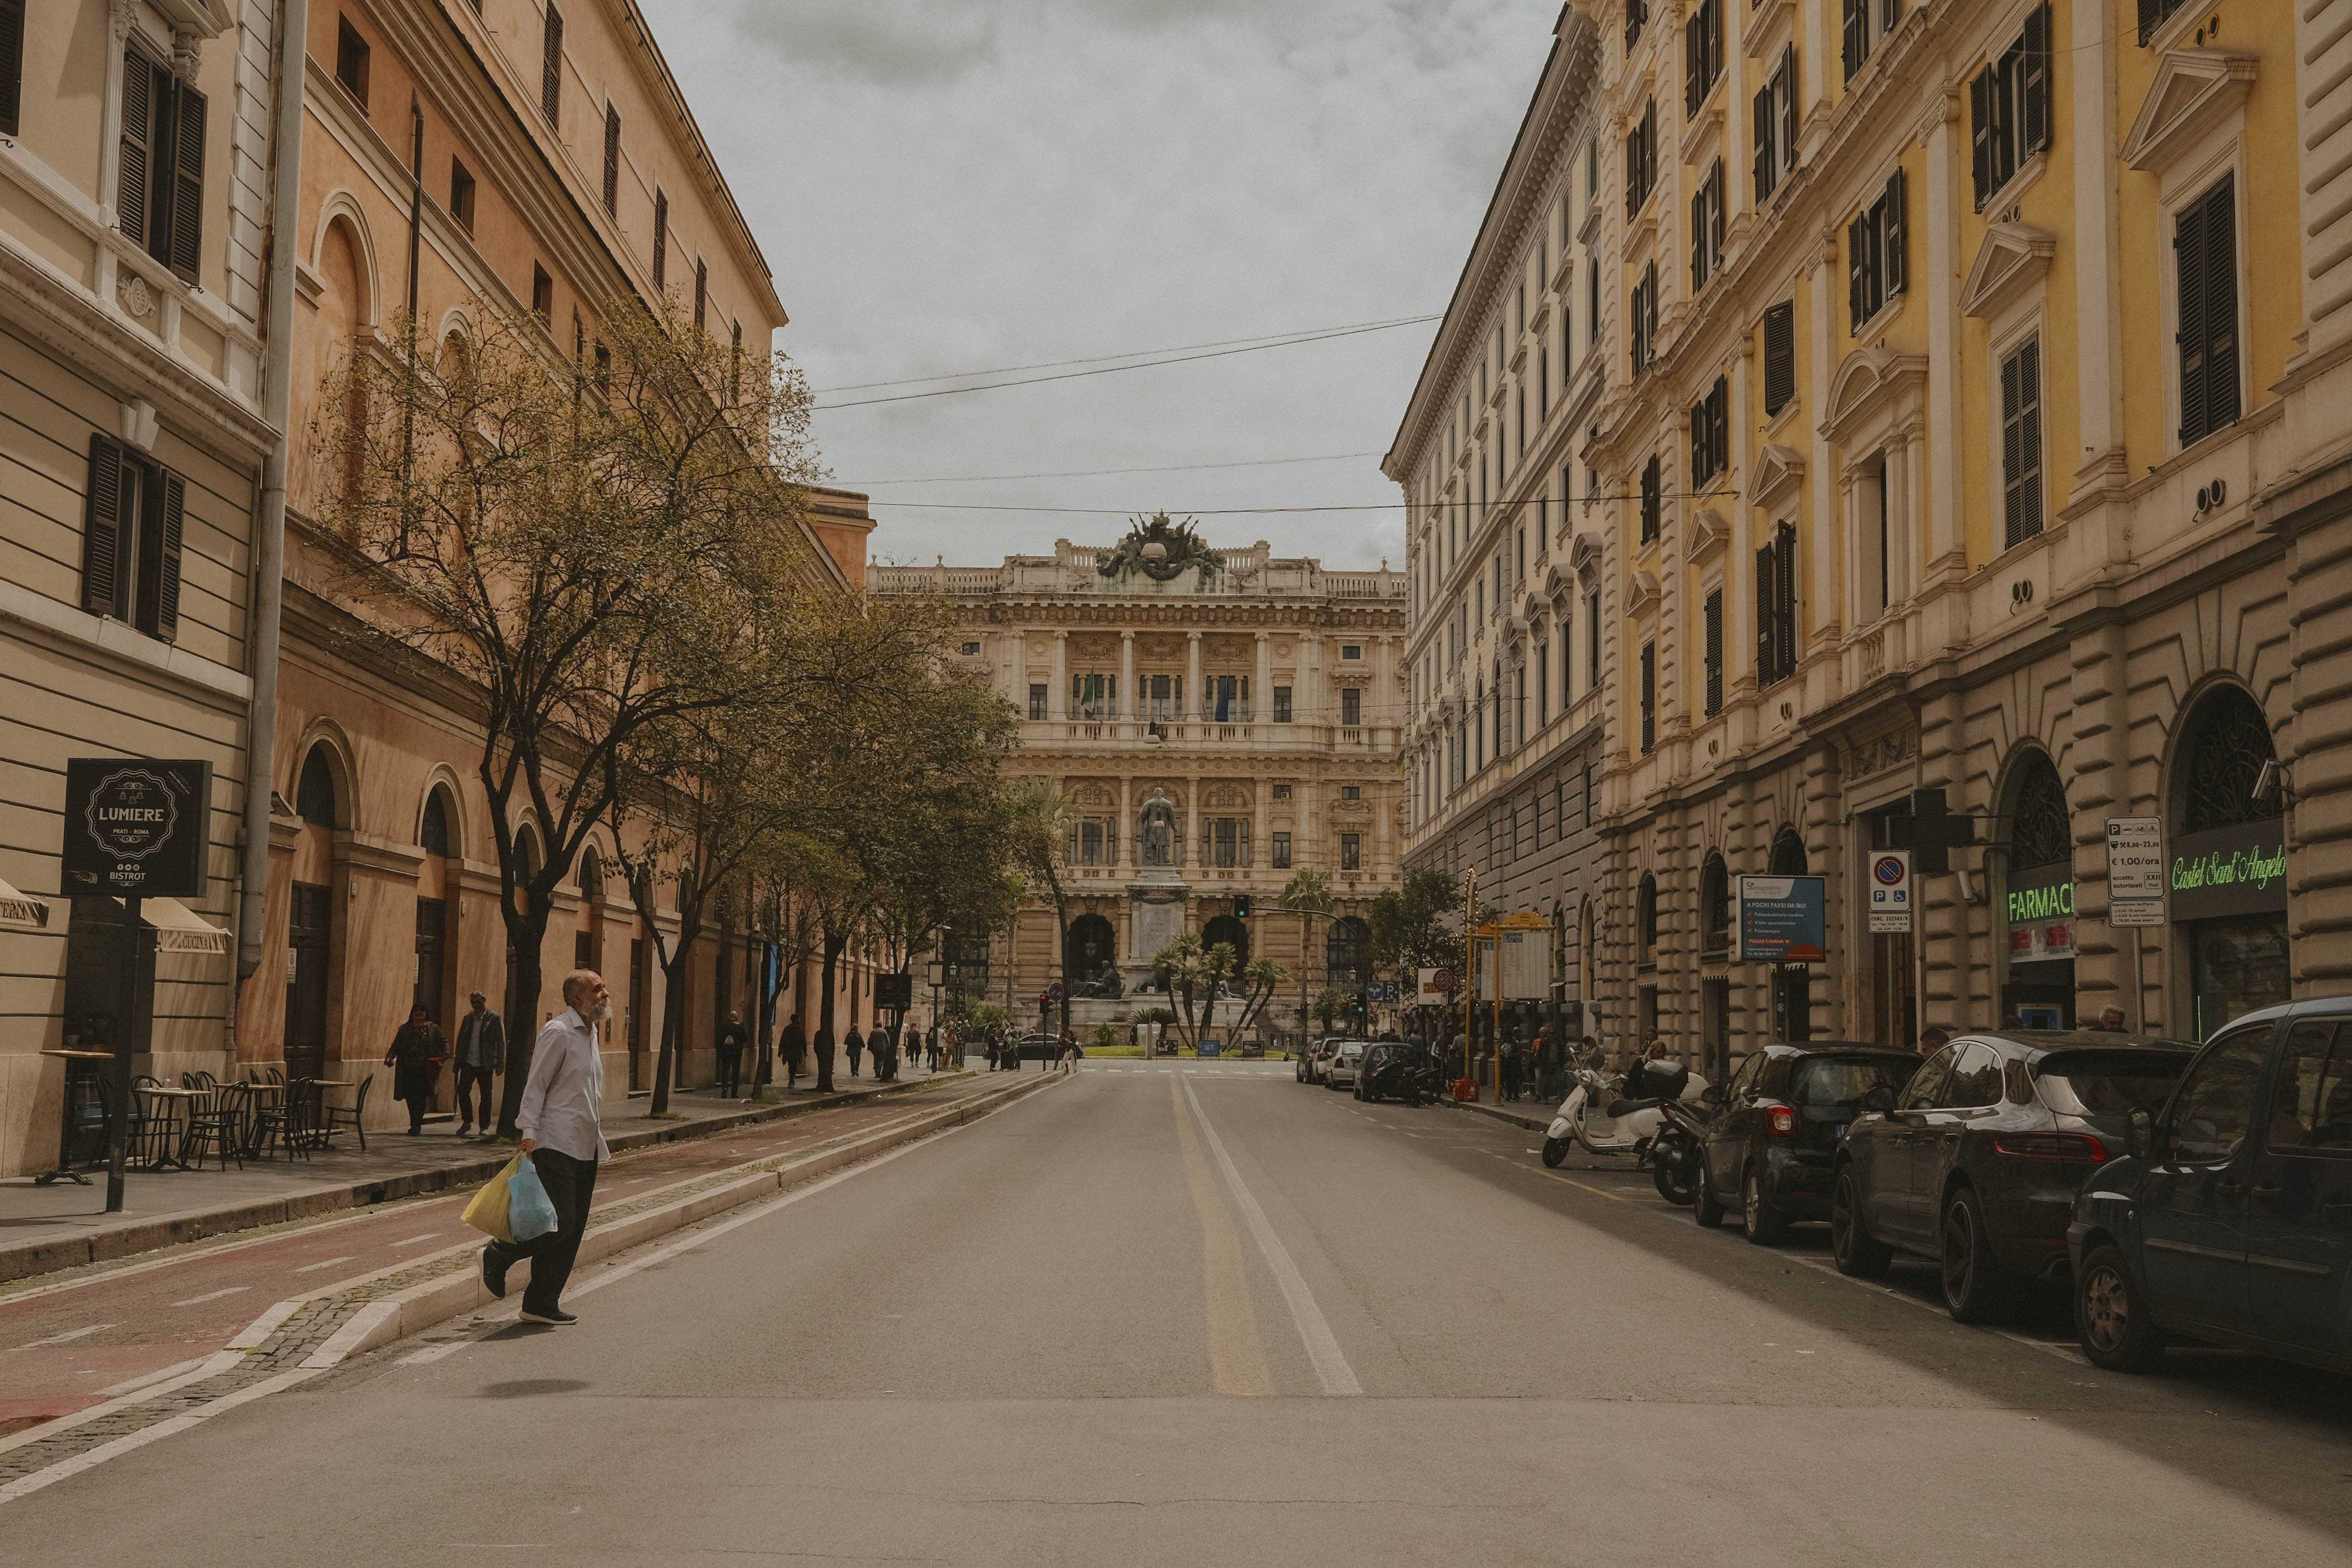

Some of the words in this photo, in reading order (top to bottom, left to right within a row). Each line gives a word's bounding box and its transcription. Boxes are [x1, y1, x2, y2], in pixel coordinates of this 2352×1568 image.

[99, 807, 164, 822] LUMIERE
[109, 872, 146, 880] BISTROT
[2172, 857, 2206, 890] Castel
[182, 935, 207, 949] CUCINA
